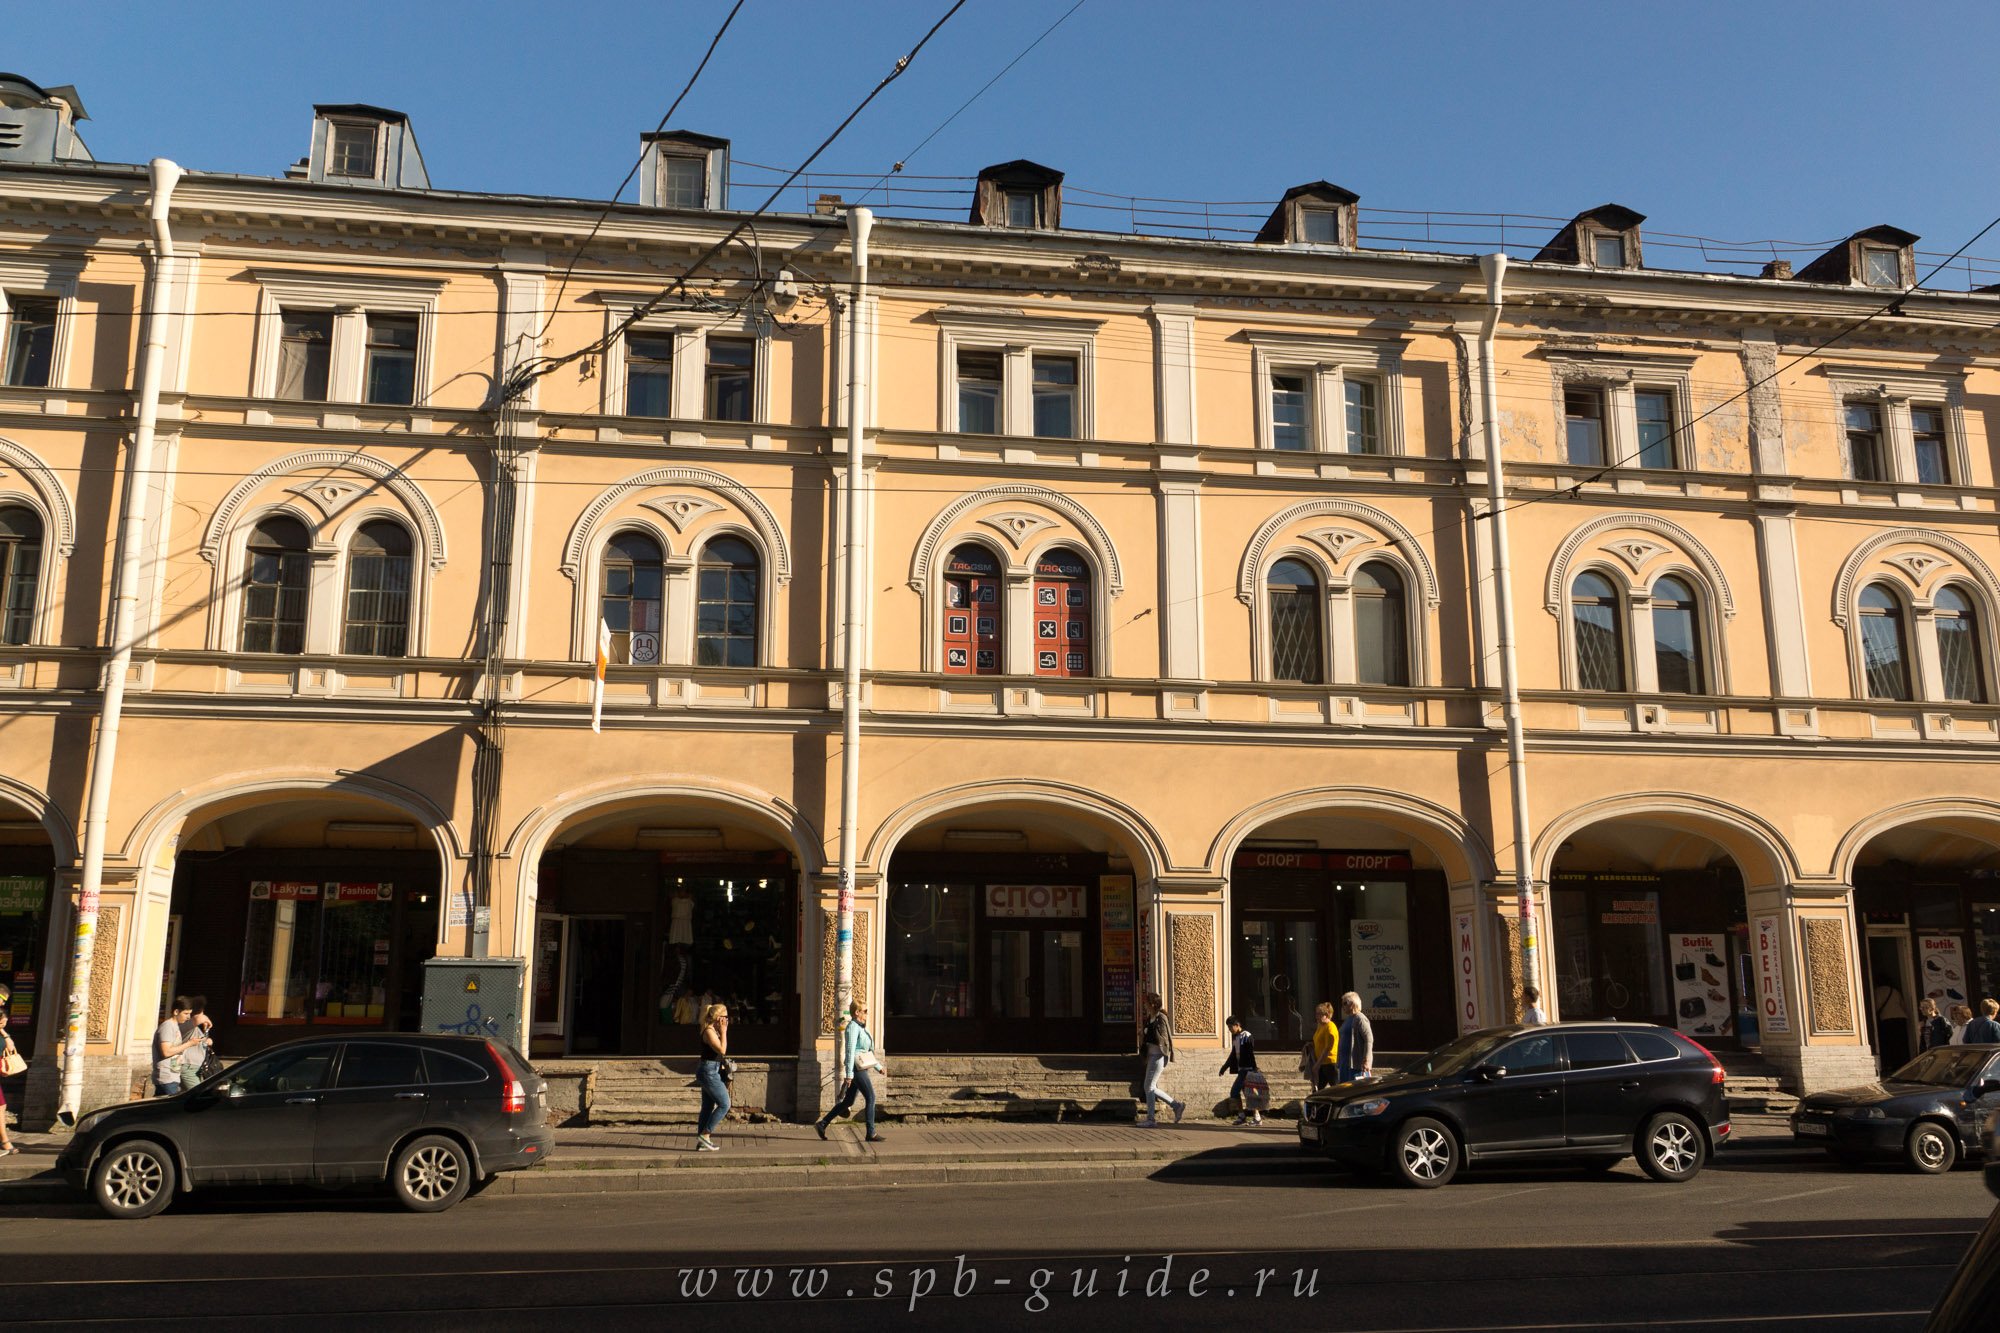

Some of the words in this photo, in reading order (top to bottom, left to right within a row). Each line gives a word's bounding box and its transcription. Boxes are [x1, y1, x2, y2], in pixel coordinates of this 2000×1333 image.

[1256, 854, 1304, 867] СПОРТ
[1346, 856, 1392, 868] СПОРТ
[272, 884, 299, 896] Laky
[341, 885, 377, 896] Fashion
[990, 886, 1082, 909] СПОРТ
[992, 908, 1081, 917] ТОВАРЫ
[1681, 937, 1713, 947] Butik
[1925, 939, 1955, 949] Butik
[1461, 934, 1475, 1020] МОТО
[1760, 933, 1777, 1017] ВЕЛО
